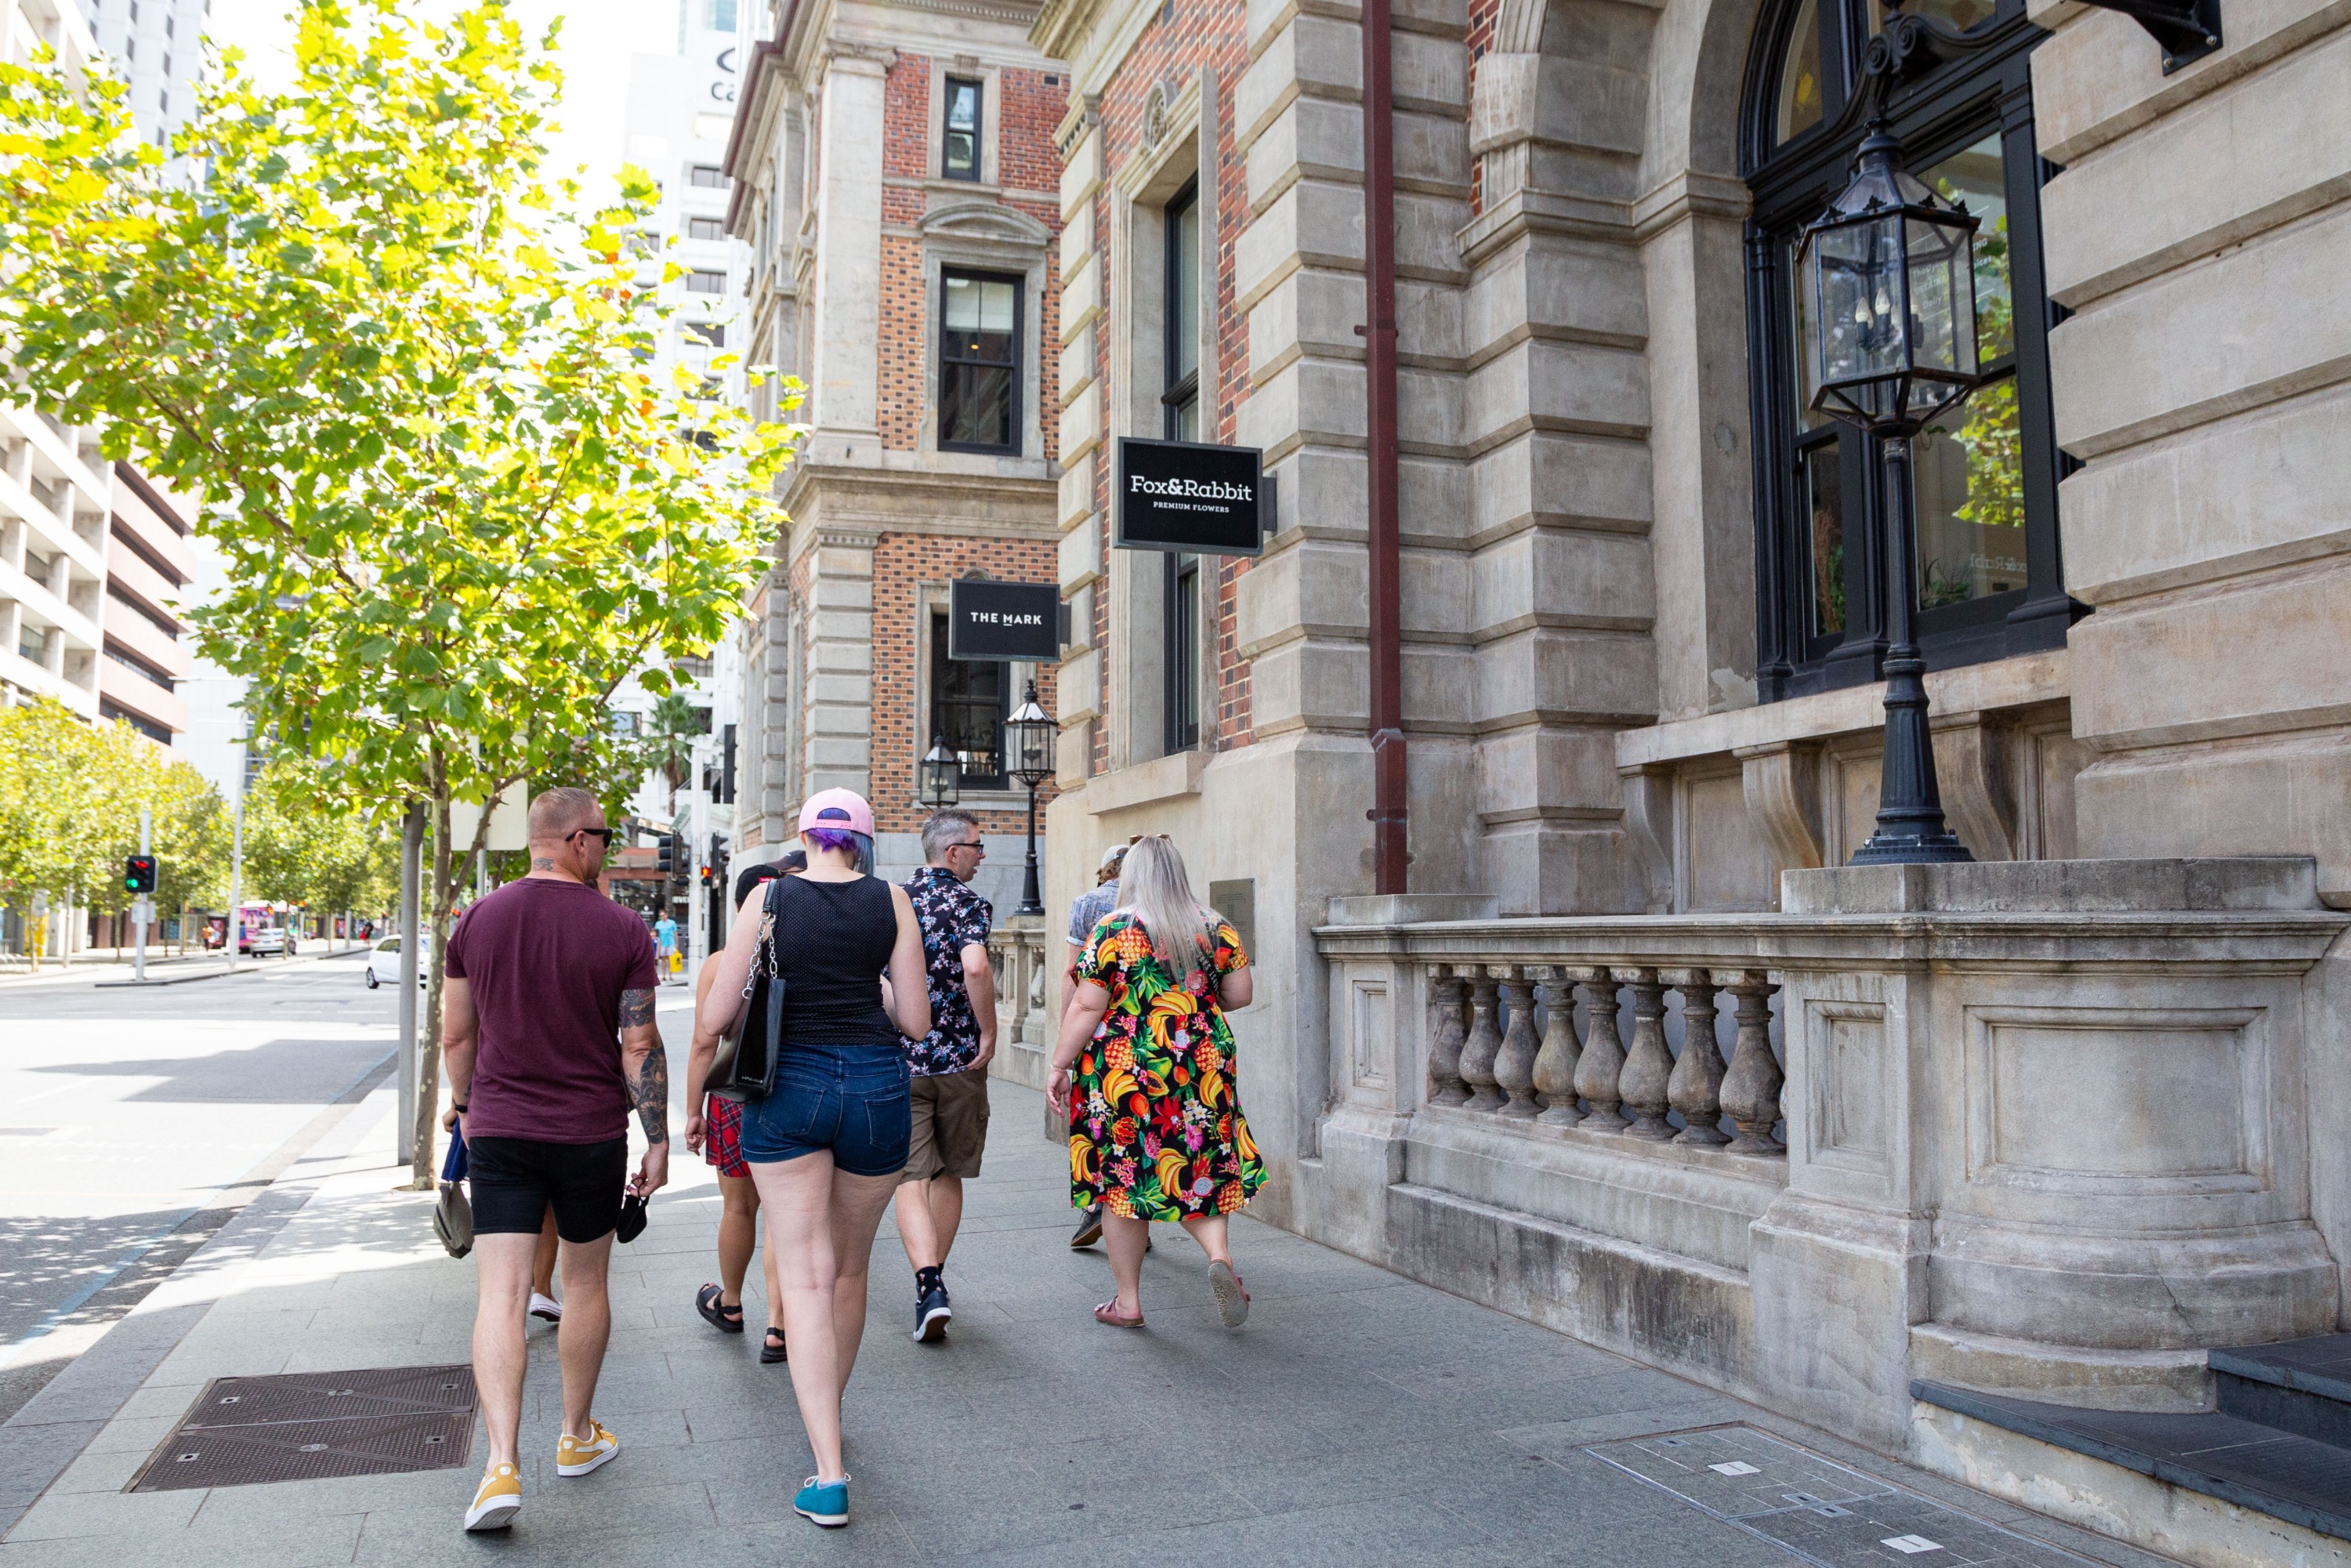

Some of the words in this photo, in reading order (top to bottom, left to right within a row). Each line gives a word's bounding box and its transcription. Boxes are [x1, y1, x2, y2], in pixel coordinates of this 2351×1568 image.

[1130, 474, 1252, 502] Fox&Rabbit
[1153, 501, 1190, 510] PREMIUM
[1193, 504, 1230, 513] FLOWERS
[971, 611, 998, 623] THE
[1003, 614, 1041, 626] MARK
